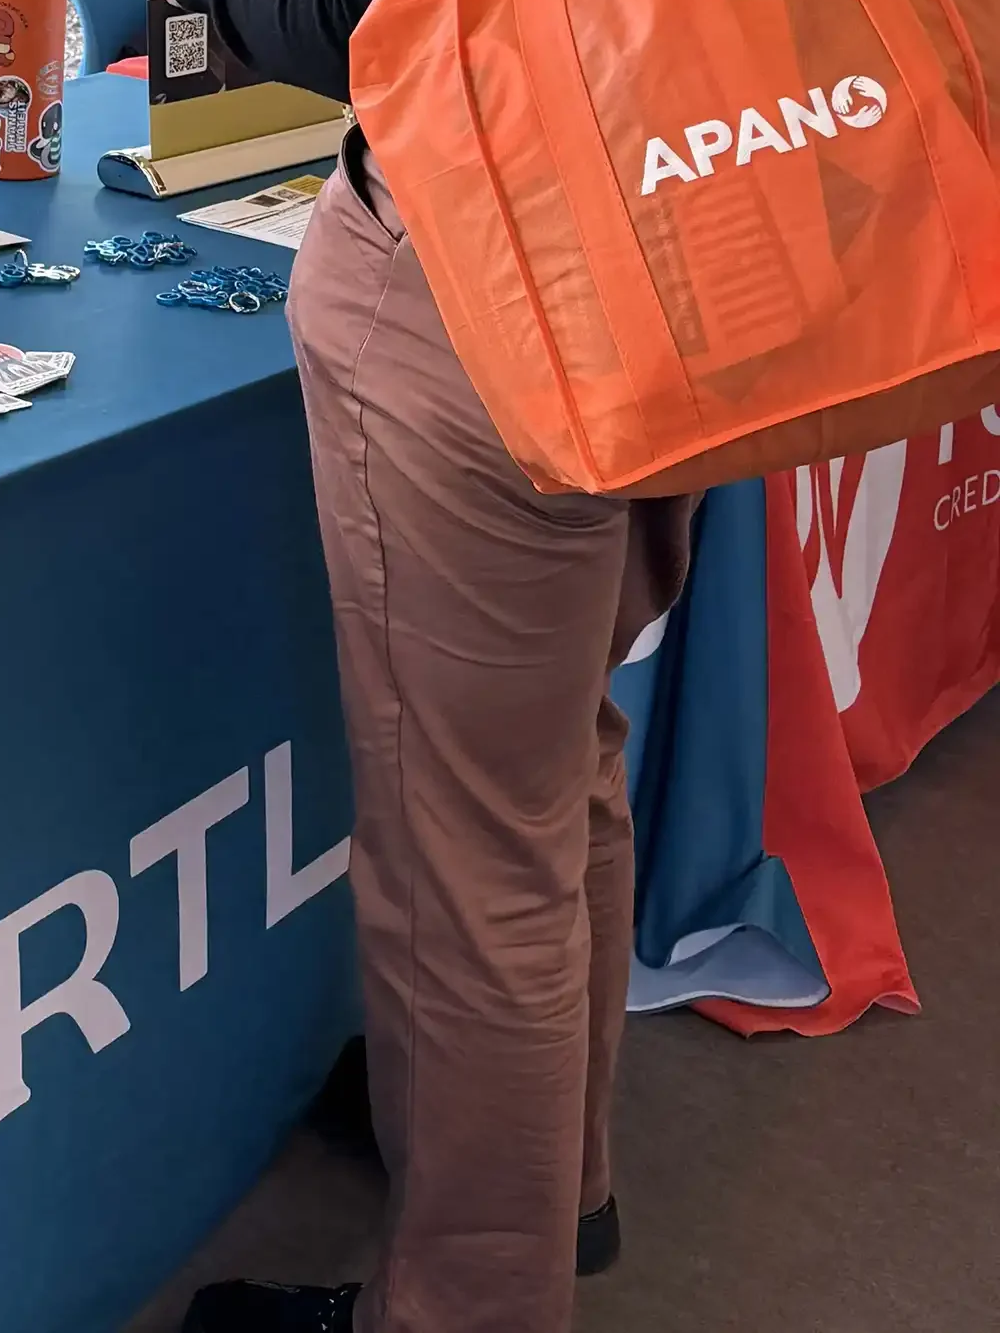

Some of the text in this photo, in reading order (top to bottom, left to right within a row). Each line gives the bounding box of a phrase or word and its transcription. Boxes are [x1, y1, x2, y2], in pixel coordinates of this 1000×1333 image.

[7, 101, 17, 149] THANKS
[16, 114, 25, 144] HATE
[640, 75, 887, 196] APANO
[933, 469, 1000, 531] CRED
